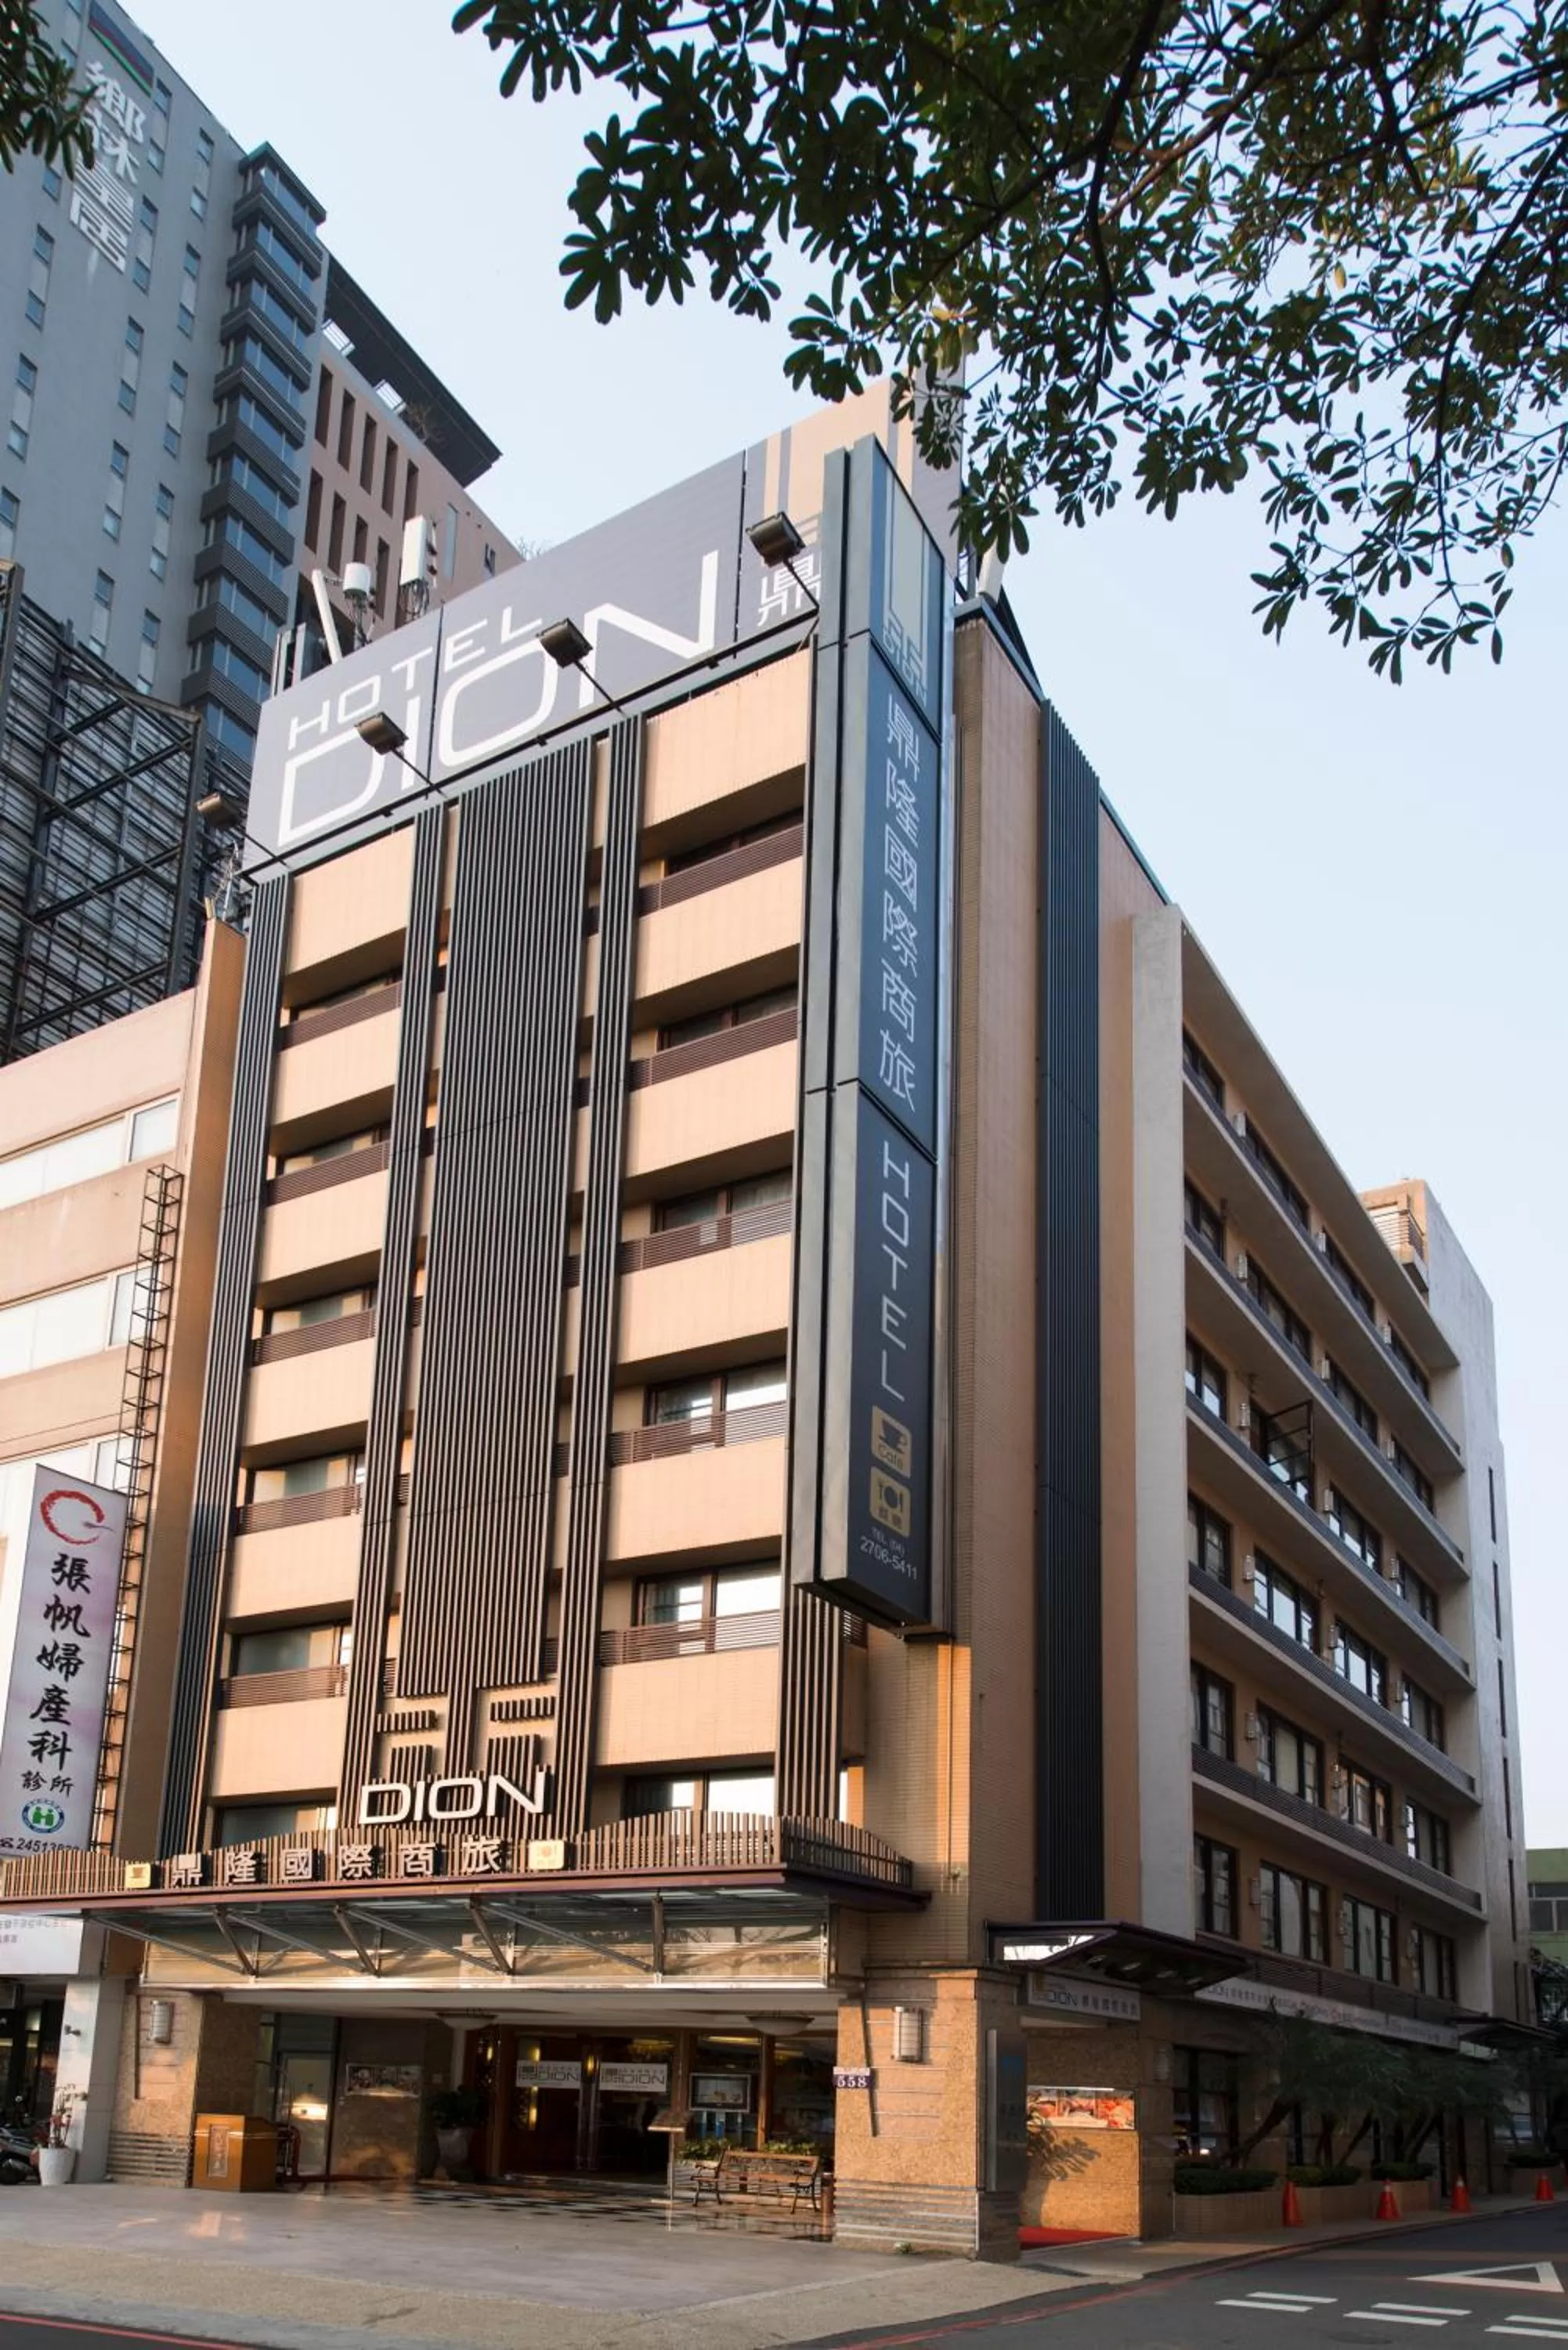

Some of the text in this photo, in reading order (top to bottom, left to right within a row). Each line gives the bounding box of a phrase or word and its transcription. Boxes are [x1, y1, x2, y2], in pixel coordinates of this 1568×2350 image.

[278, 551, 719, 847] DION
[288, 606, 543, 750] HOTEL
[880, 693, 919, 1113] 鼎隆國際商旅
[882, 1141, 910, 1401] HOTEL
[28, 1553, 91, 1771] 張帆婦產科
[20, 1770, 74, 1799] 診所
[359, 1770, 545, 1824] DION
[16, 1836, 81, 1853] 24513
[172, 1836, 501, 1886] 鼎隆國際商旅
[837, 2075, 867, 2088] 558
